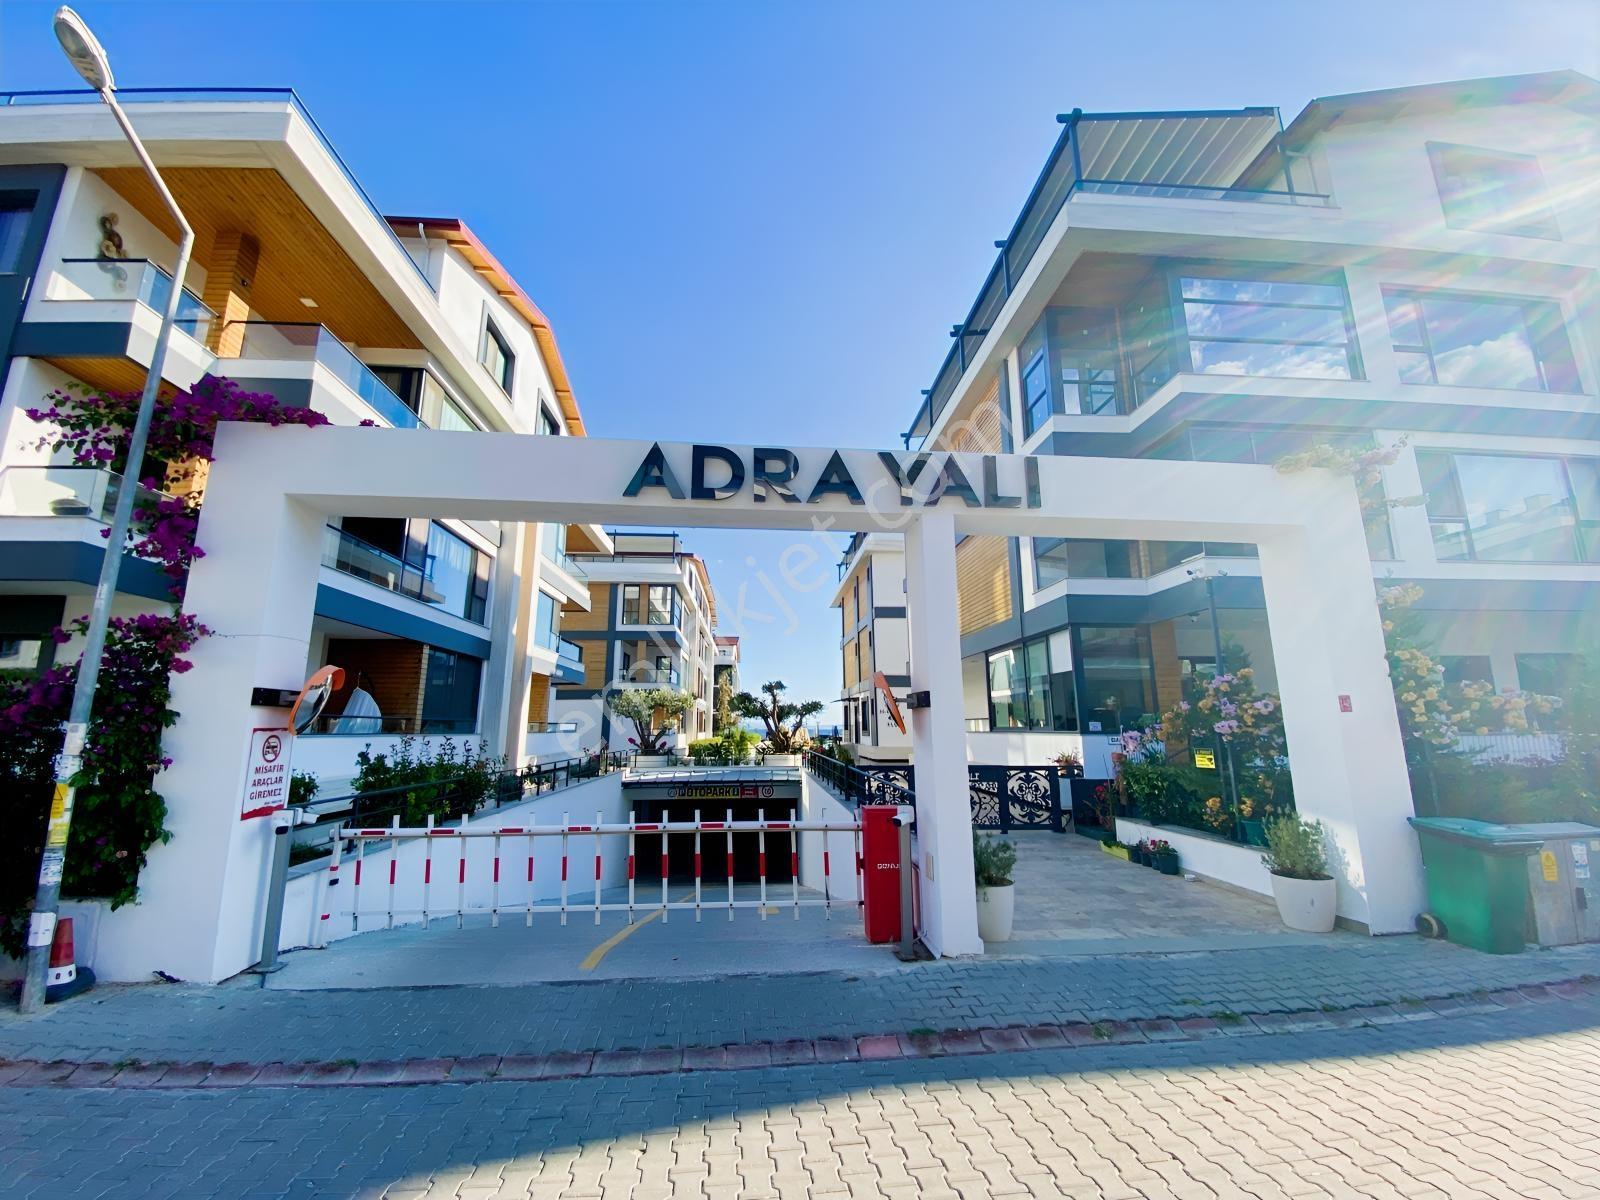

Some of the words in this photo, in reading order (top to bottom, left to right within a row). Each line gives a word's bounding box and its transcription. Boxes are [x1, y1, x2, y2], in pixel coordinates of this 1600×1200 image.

[622, 441, 1042, 509] ADRAYALI
[255, 764, 284, 774] MİSAFİR
[252, 776, 284, 787] ARAÇLAR
[249, 788, 282, 800] GİREMEZ
